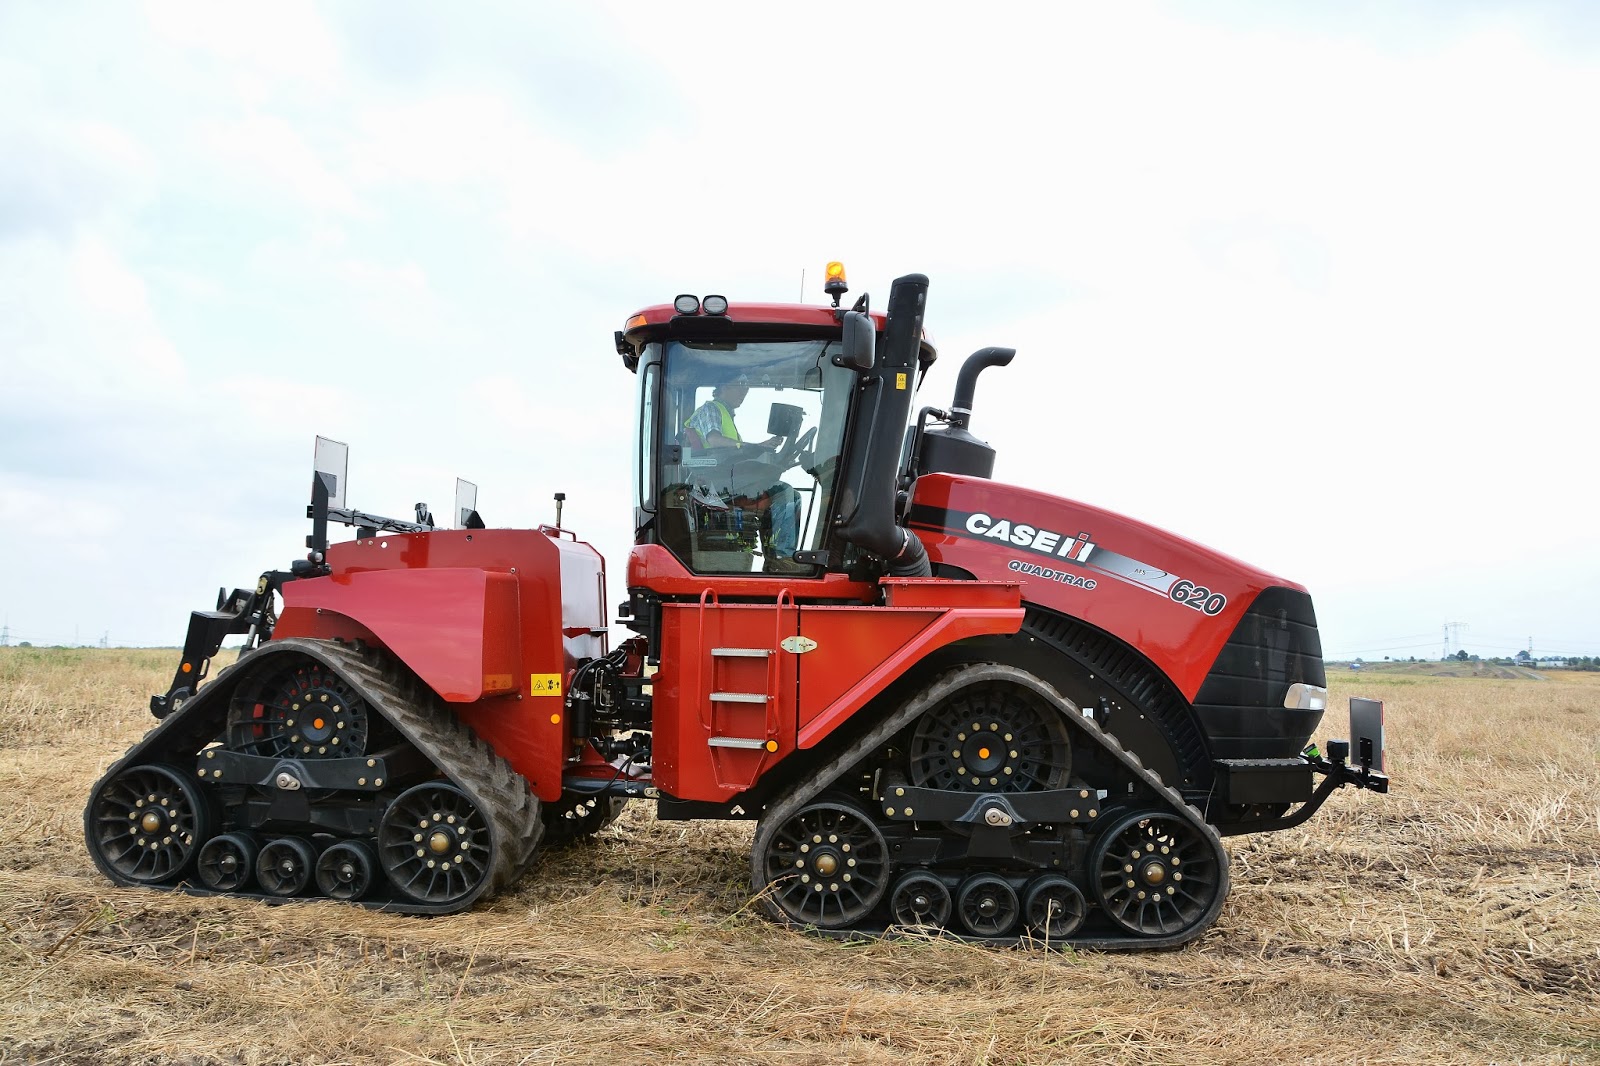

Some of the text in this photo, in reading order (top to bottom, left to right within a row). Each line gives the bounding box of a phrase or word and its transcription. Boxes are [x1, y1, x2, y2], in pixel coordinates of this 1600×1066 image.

[966, 513, 1060, 553] CASE
[1008, 560, 1097, 590] QUADTRAC
[1170, 580, 1227, 616] 620
